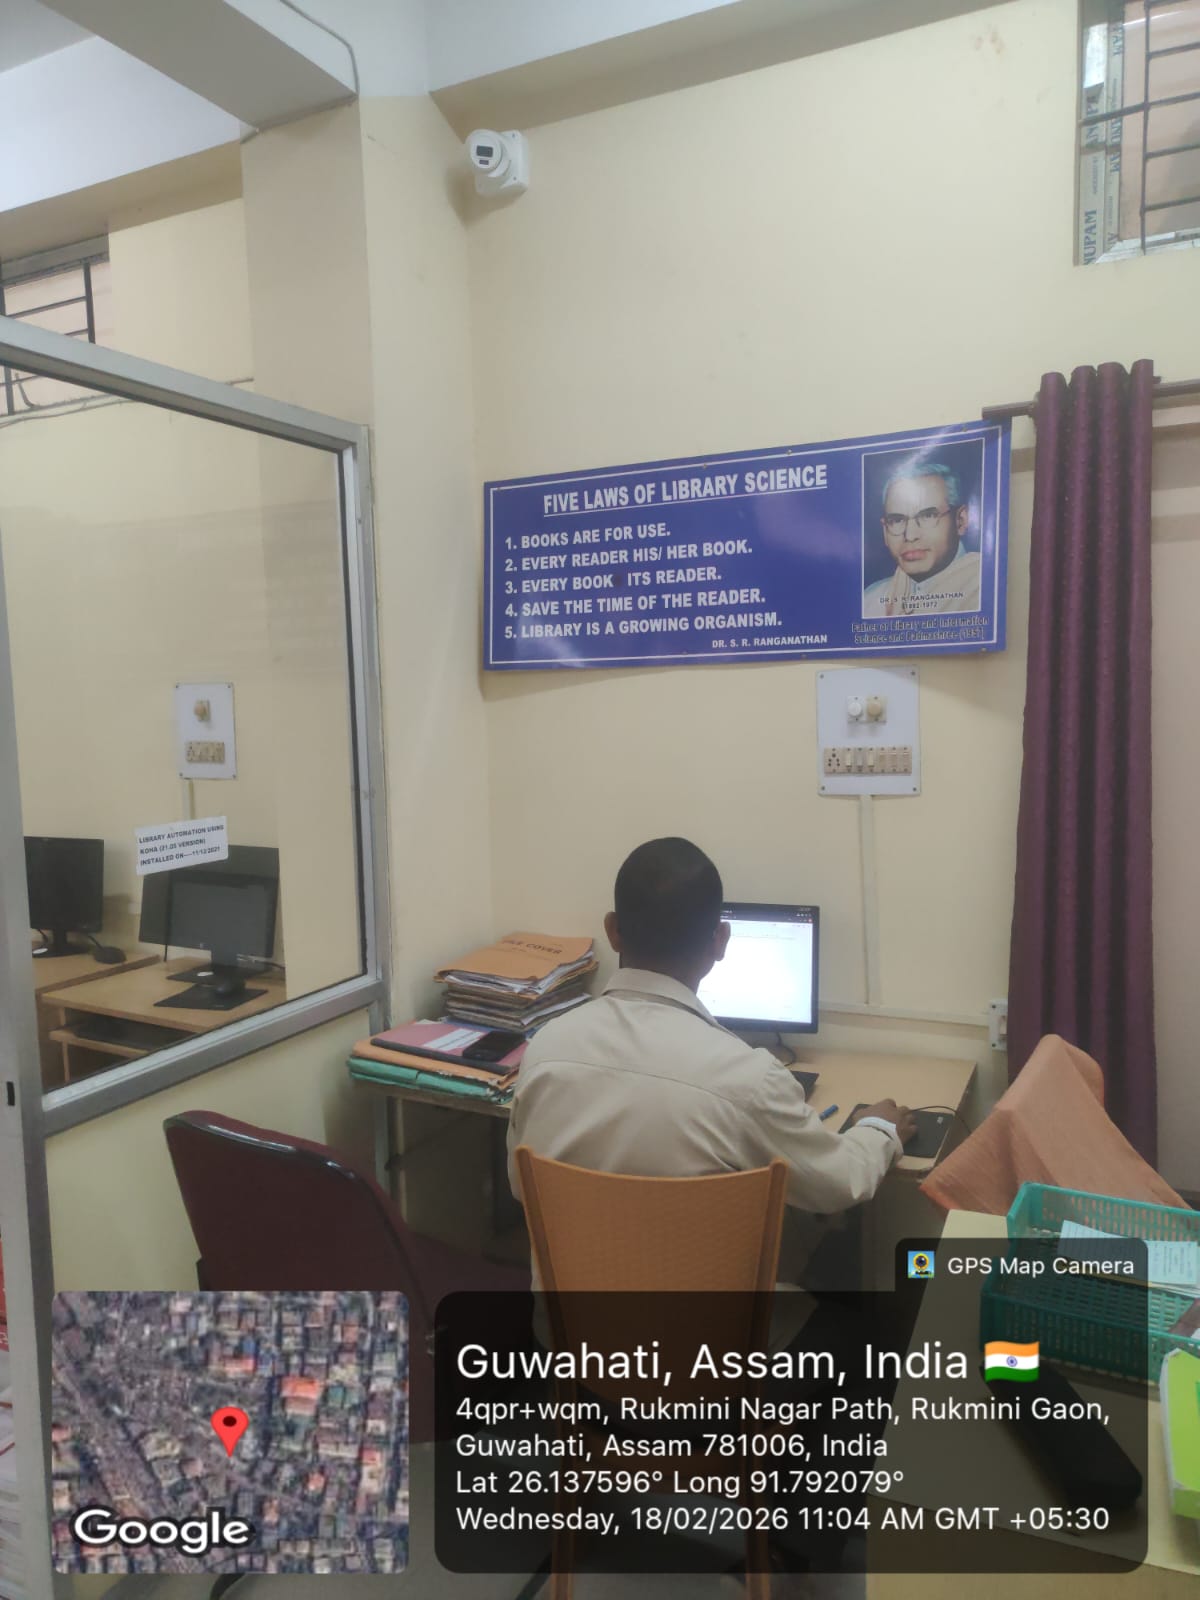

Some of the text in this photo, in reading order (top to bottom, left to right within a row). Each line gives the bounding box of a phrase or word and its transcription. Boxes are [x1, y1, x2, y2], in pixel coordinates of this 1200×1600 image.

[544, 464, 827, 514] FIVE LAWS OF LIBRARY SCIENCE
[505, 522, 671, 550] 1. BOOKS ARE FOR USE.
[505, 539, 752, 571] 2. EVERY READER HIS/ HER BOOK.
[505, 566, 722, 594] 3. EVERY BOOK ITS READER.
[505, 588, 766, 617] 4. SAVE THE TIME OF THE READER.
[910, 592, 964, 602] RANGANATHAN
[504, 612, 782, 639] 5. LIBRARY IS A GROWING ORGANISM.
[712, 634, 828, 648] DR. S. R. RANGANATHAN
[138, 825, 224, 844] LIBRARY AUTOMATION USING
[140, 846, 159, 855] KOHA
[178, 839, 206, 848] VERSION)
[140, 855, 174, 866] INSTALLED
